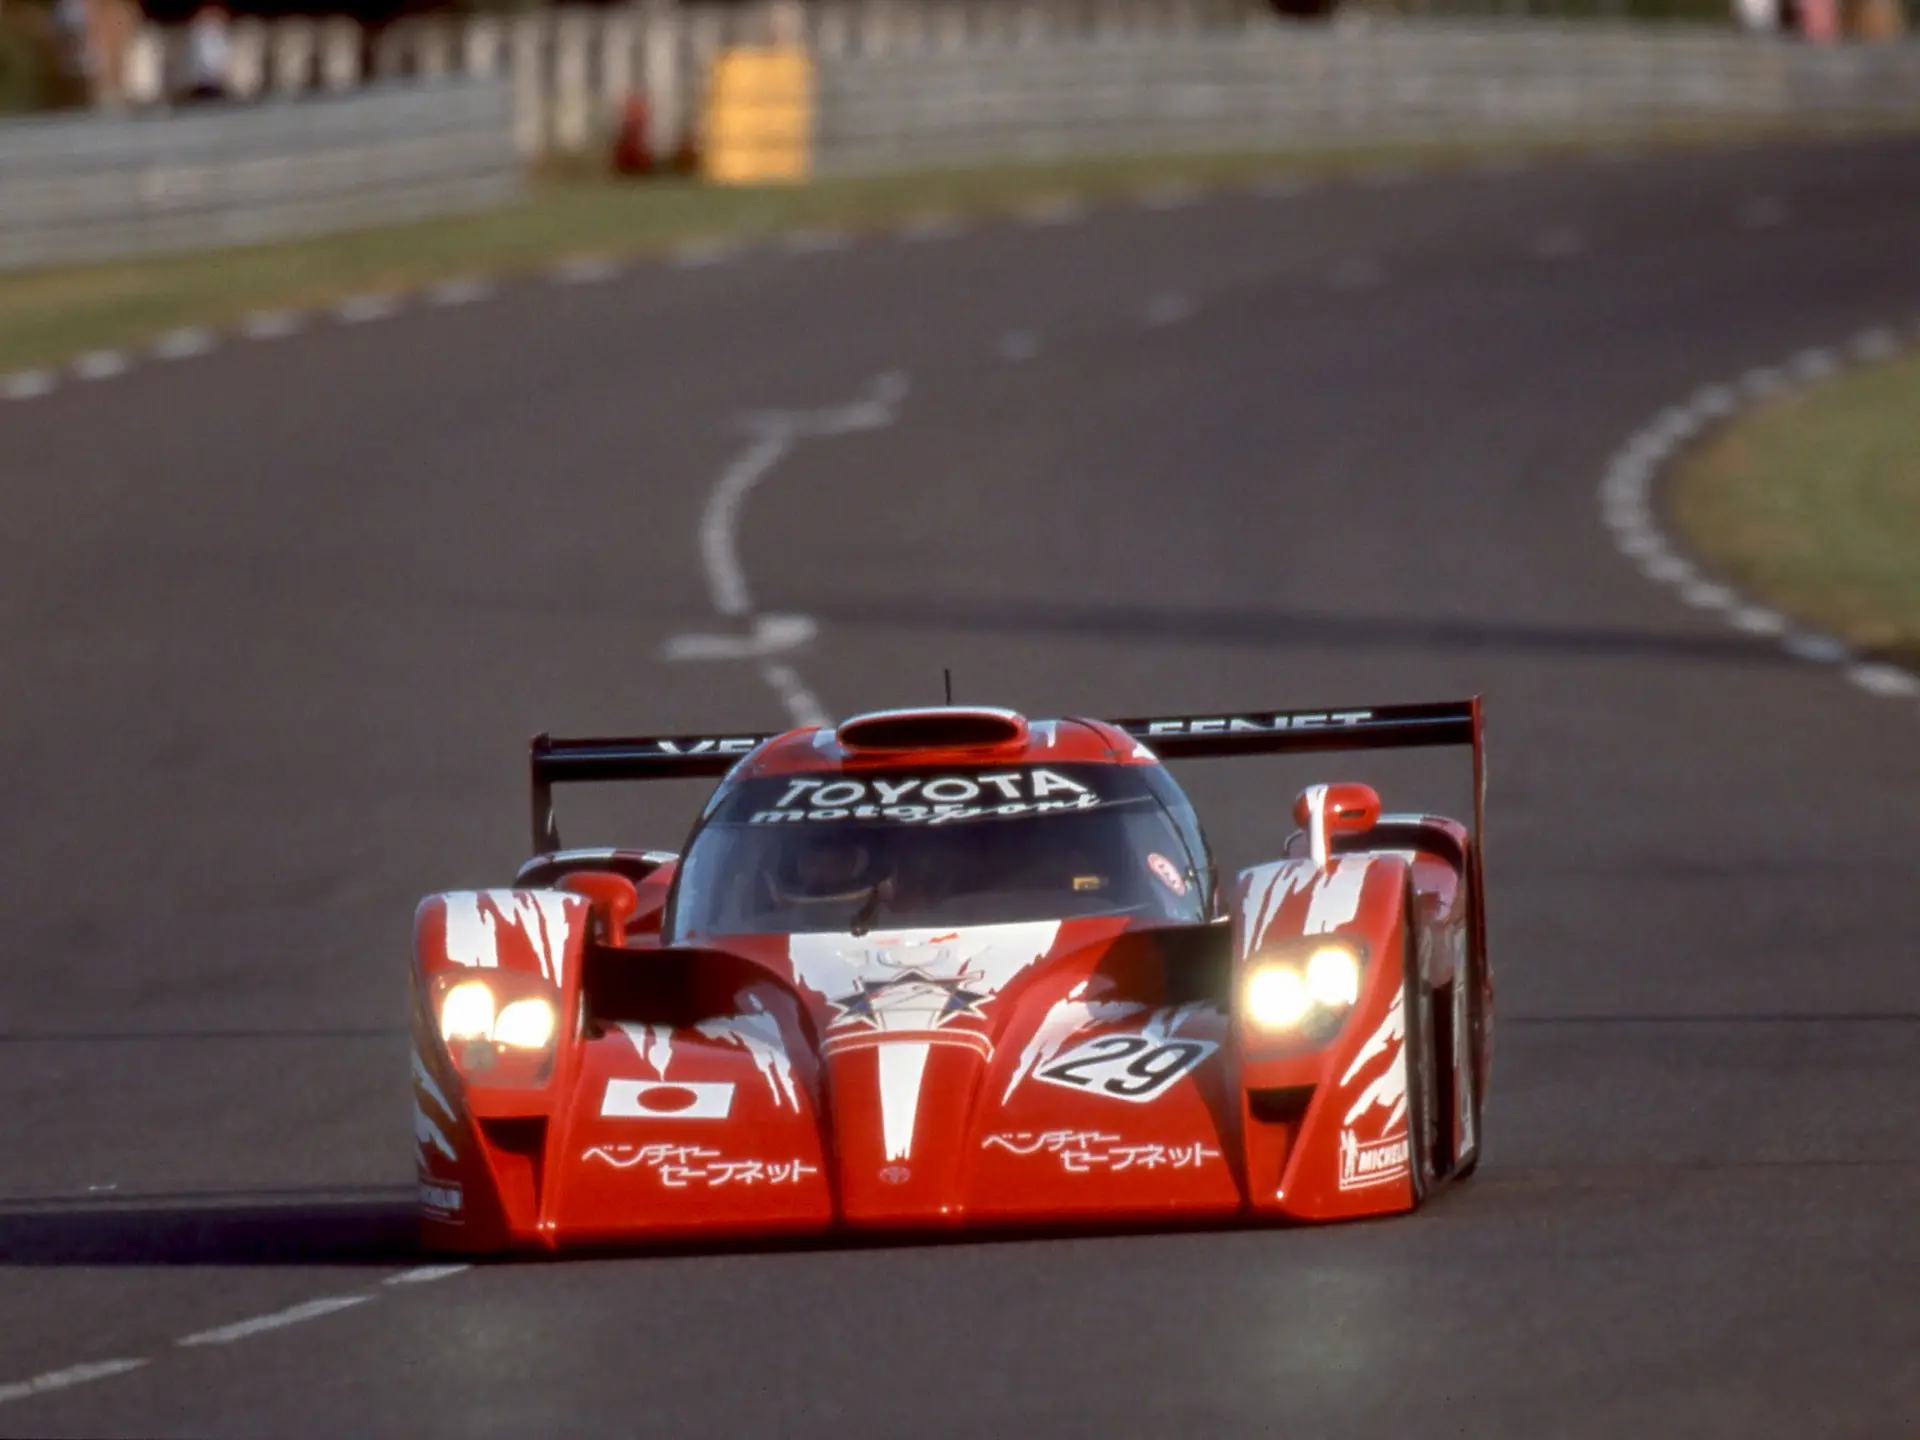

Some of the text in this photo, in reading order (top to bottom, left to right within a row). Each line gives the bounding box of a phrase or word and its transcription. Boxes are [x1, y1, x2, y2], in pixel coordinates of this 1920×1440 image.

[657, 738, 768, 754] VE
[776, 768, 1088, 808] TOYOTA
[1040, 1037, 1203, 1096] 29
[581, 1143, 721, 1168] ベンチャー
[979, 1128, 1121, 1155] ベンチャー
[1060, 1141, 1220, 1172] セーフネット
[659, 1157, 817, 1187] セーフネット
